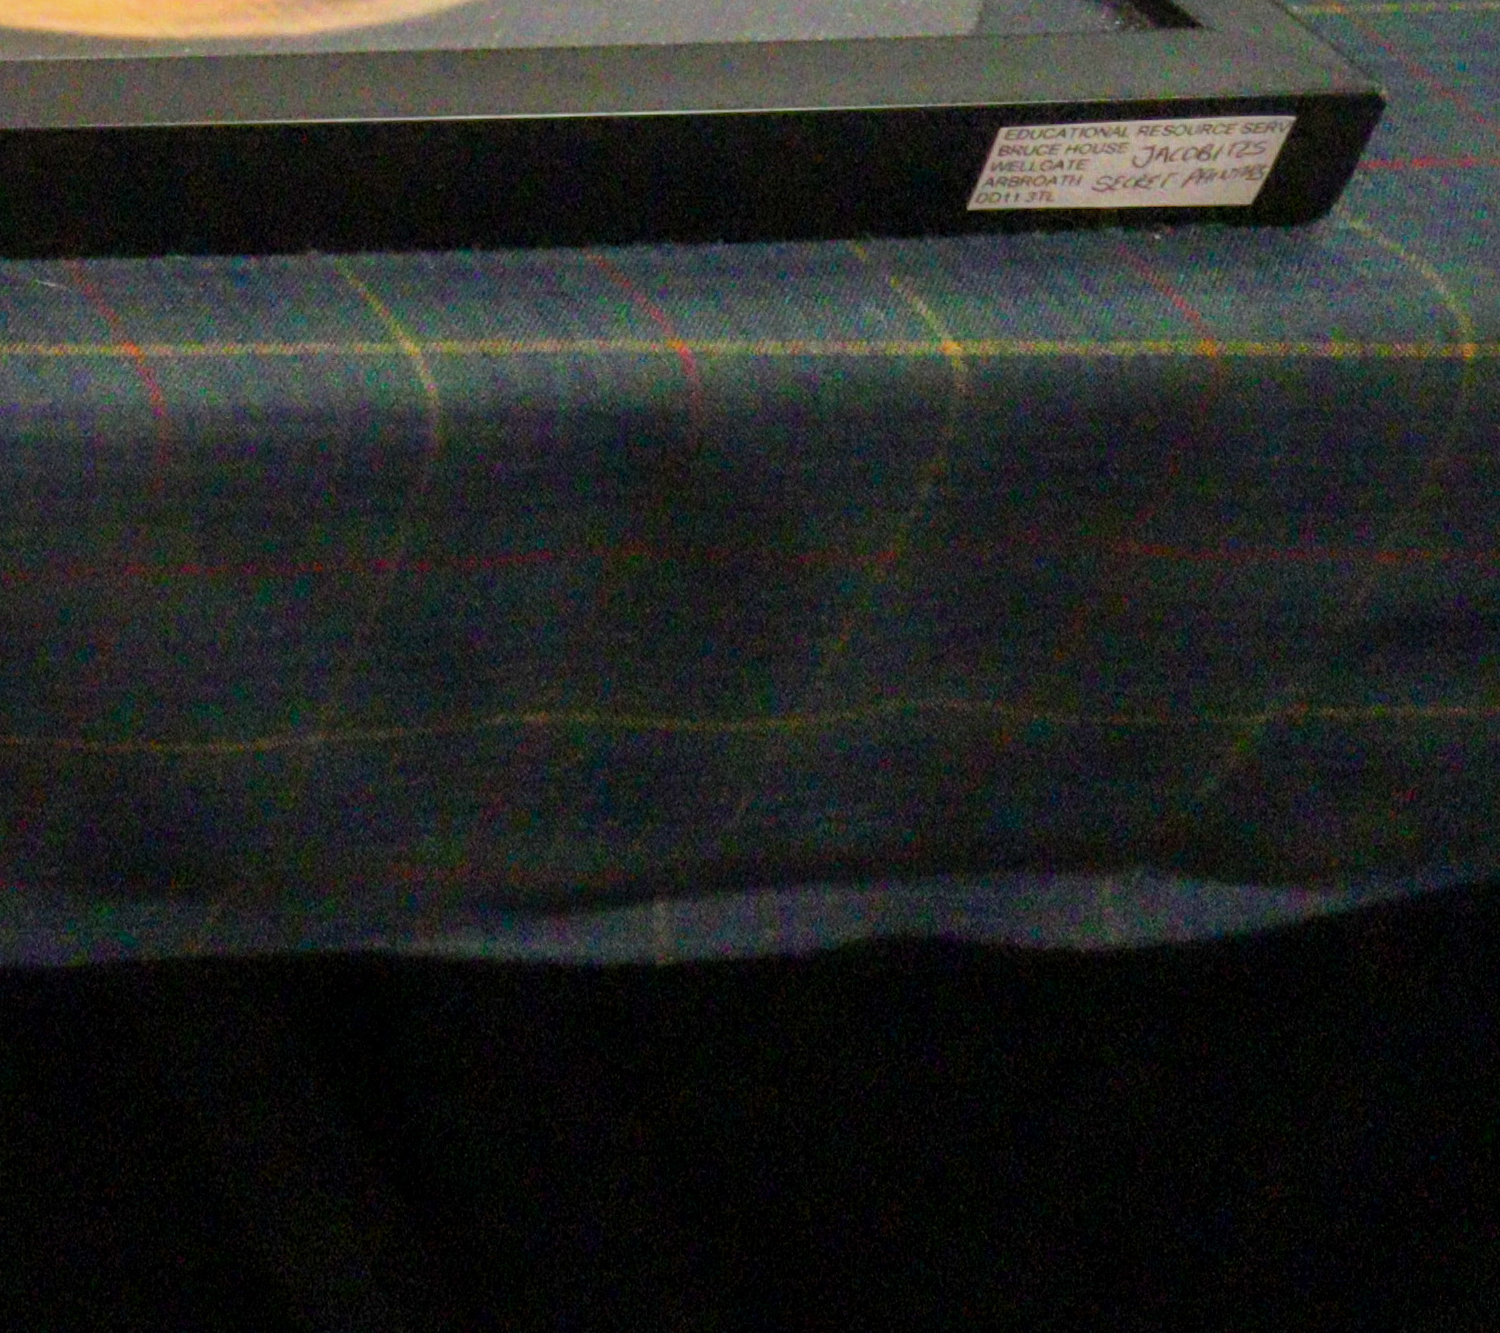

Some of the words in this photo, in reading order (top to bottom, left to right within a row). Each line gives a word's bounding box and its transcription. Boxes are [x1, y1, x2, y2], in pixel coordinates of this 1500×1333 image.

[1004, 127, 1129, 140] EDUCATIONAL
[1138, 123, 1236, 136] RESOURCE
[998, 143, 1062, 157] BRUCE
[1065, 142, 1130, 154] HOUSE
[990, 159, 1089, 172] WELLGATE
[981, 175, 1083, 188] ARBROATH
